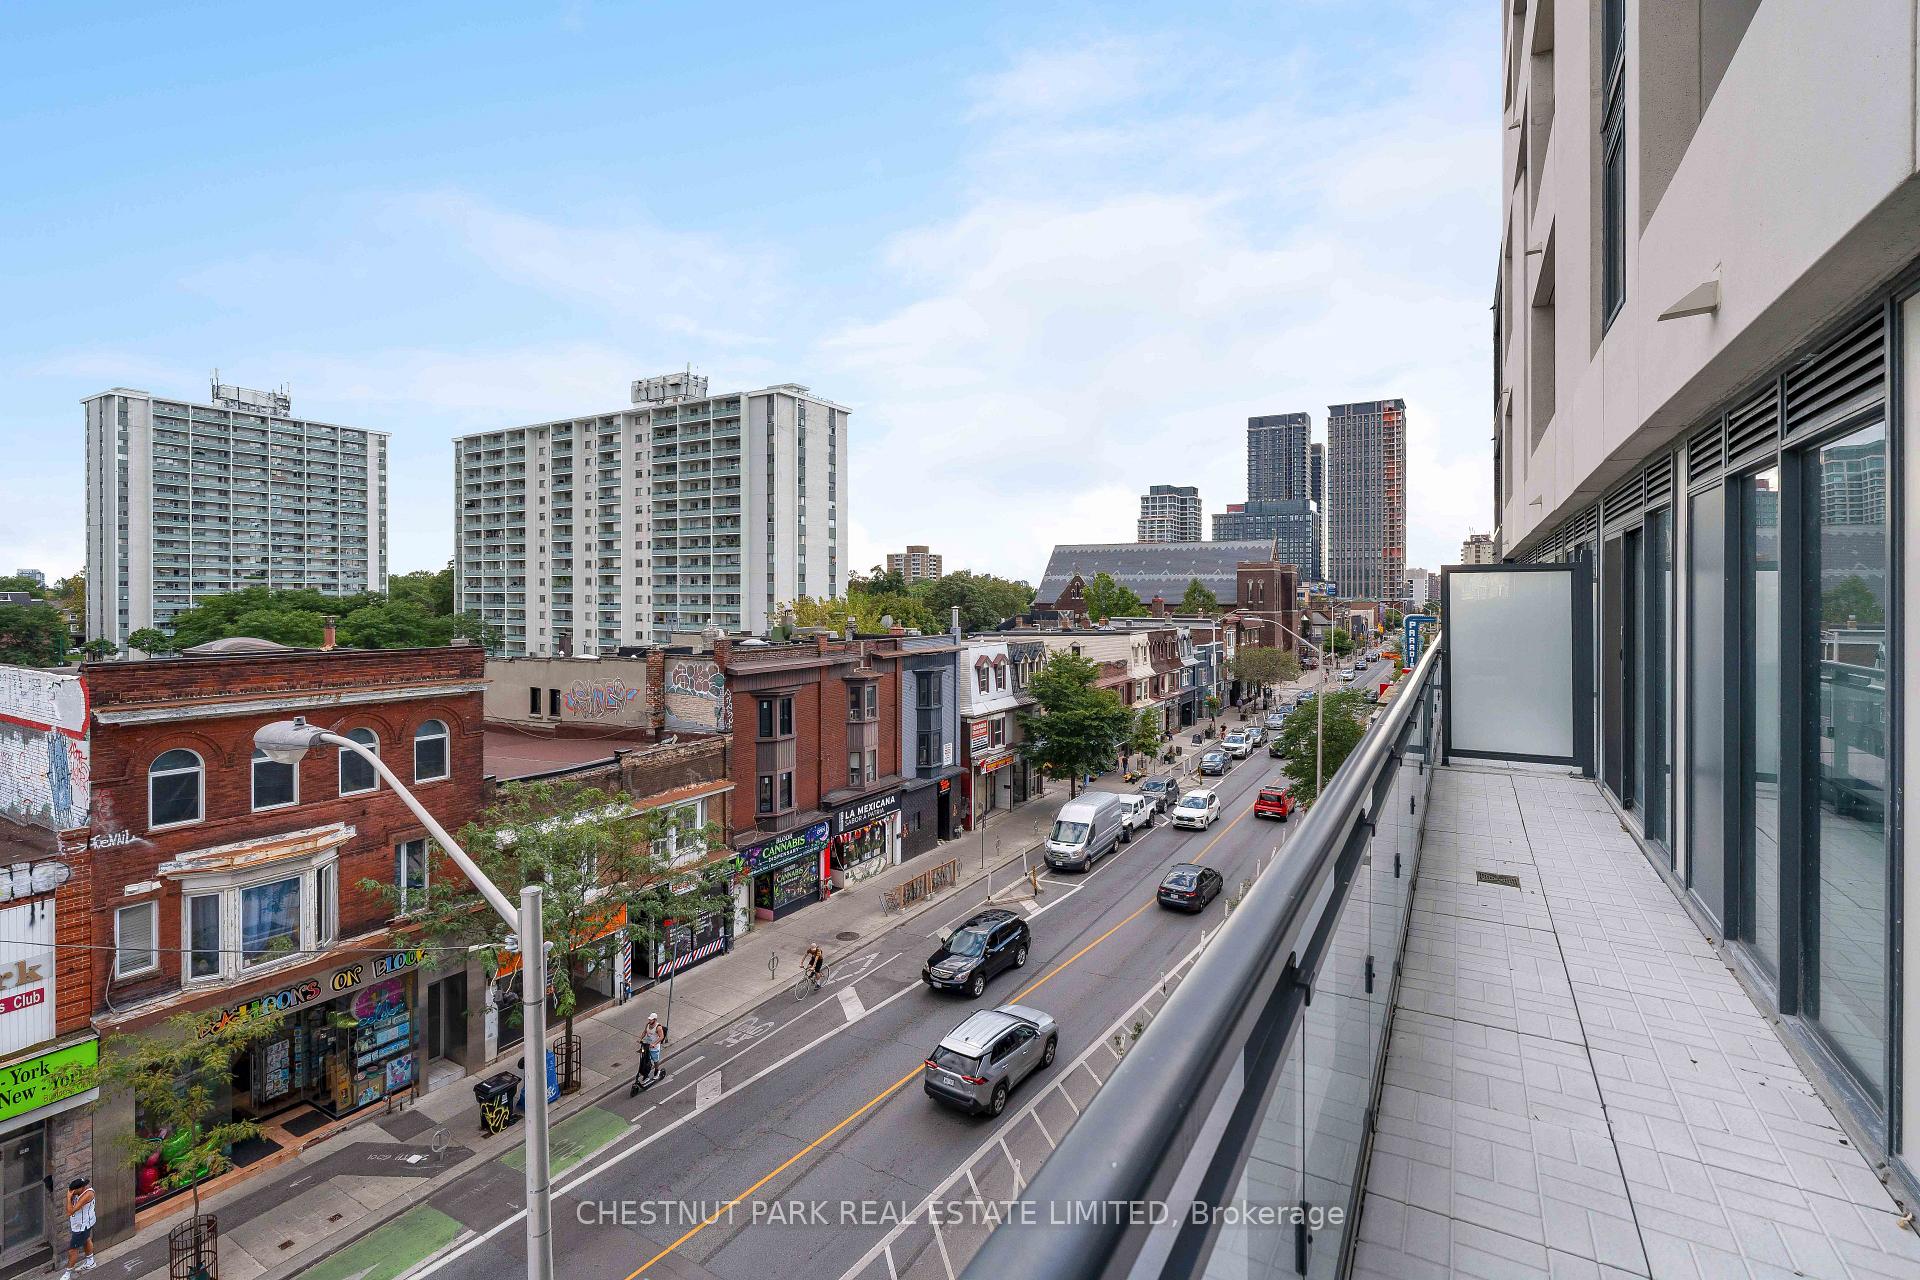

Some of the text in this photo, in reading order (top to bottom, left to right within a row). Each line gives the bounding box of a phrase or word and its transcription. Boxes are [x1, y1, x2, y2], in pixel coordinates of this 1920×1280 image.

[845, 796, 895, 819] LA MEXICANA
[844, 815, 863, 827] SABOR
[762, 835, 806, 858] CANNABIS
[776, 834, 793, 844] BLOOR
[331, 965, 363, 991] ON
[13, 992, 41, 1009] Club
[10, 1061, 50, 1086] York
[0, 1085, 36, 1109] New
